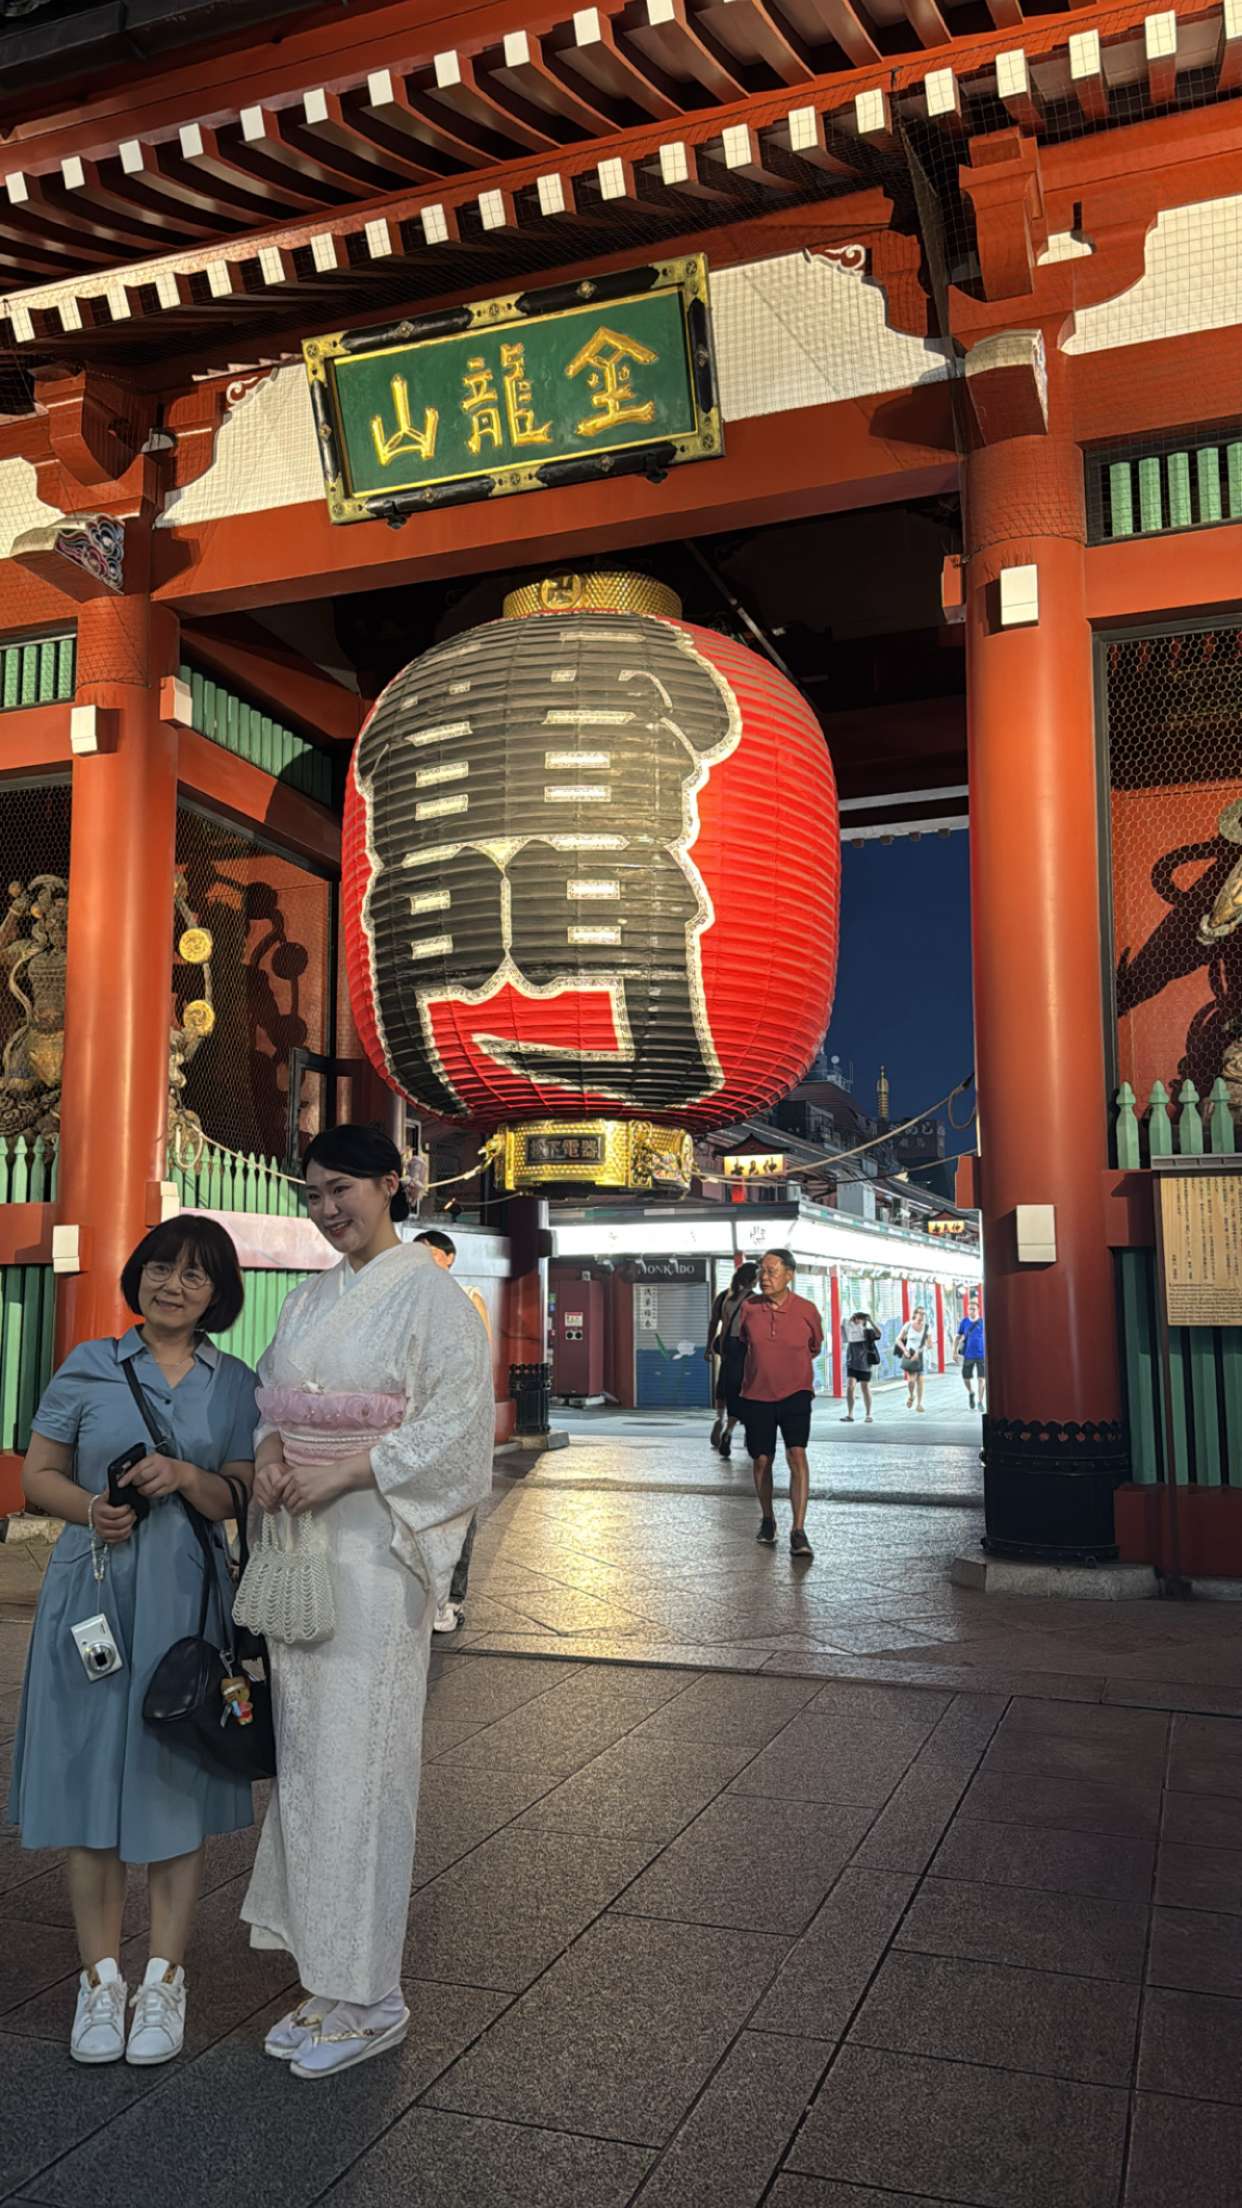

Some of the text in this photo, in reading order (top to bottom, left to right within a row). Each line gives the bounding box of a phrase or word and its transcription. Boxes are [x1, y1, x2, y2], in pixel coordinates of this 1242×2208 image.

[371, 325, 659, 467] 金龍山
[352, 613, 743, 1117] 雷門
[639, 1264, 695, 1276] ONKDO
